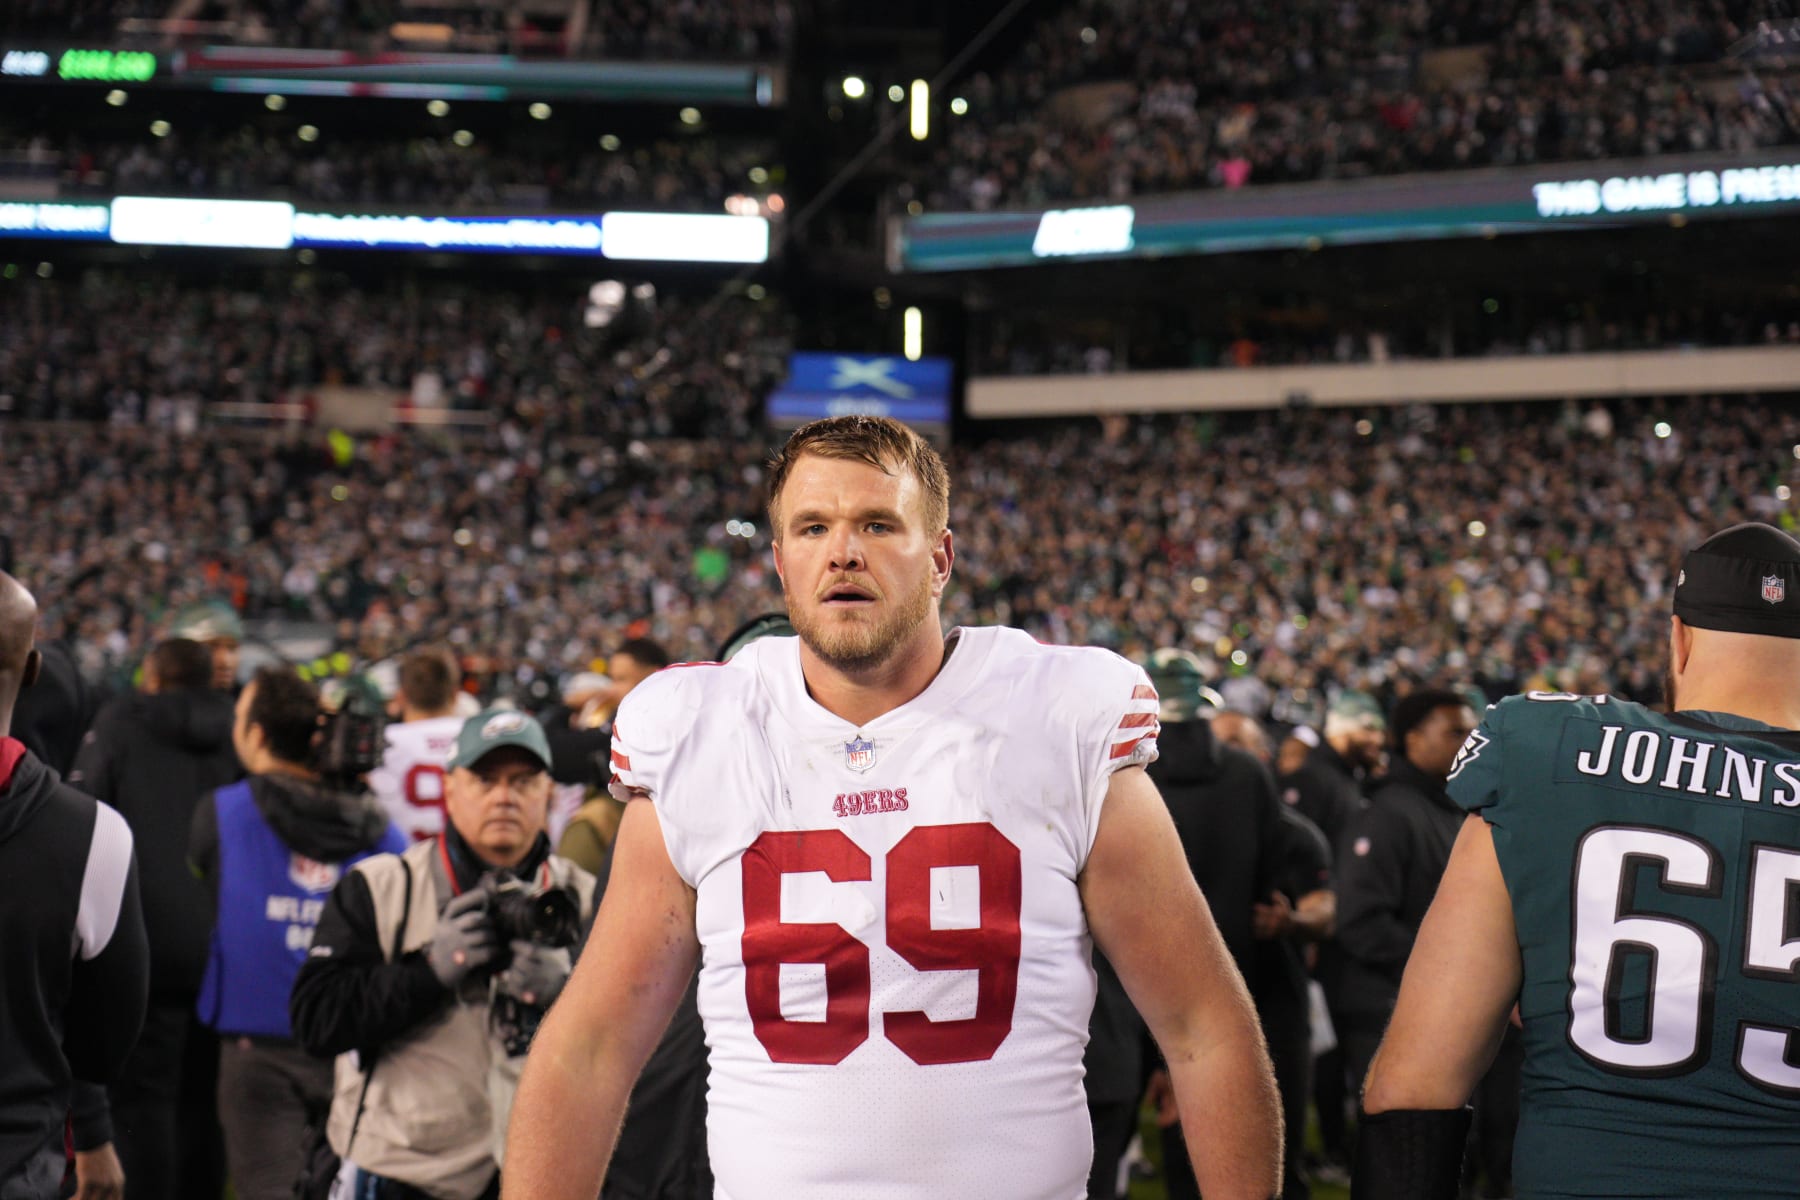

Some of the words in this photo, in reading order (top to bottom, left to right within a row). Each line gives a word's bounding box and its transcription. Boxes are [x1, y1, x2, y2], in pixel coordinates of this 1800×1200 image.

[1601, 173, 1687, 212] GAME
[1687, 171, 1720, 206] IS
[1576, 725, 1800, 808] JOHNS
[832, 787, 909, 818] 49ERS
[741, 822, 1021, 1065] 69
